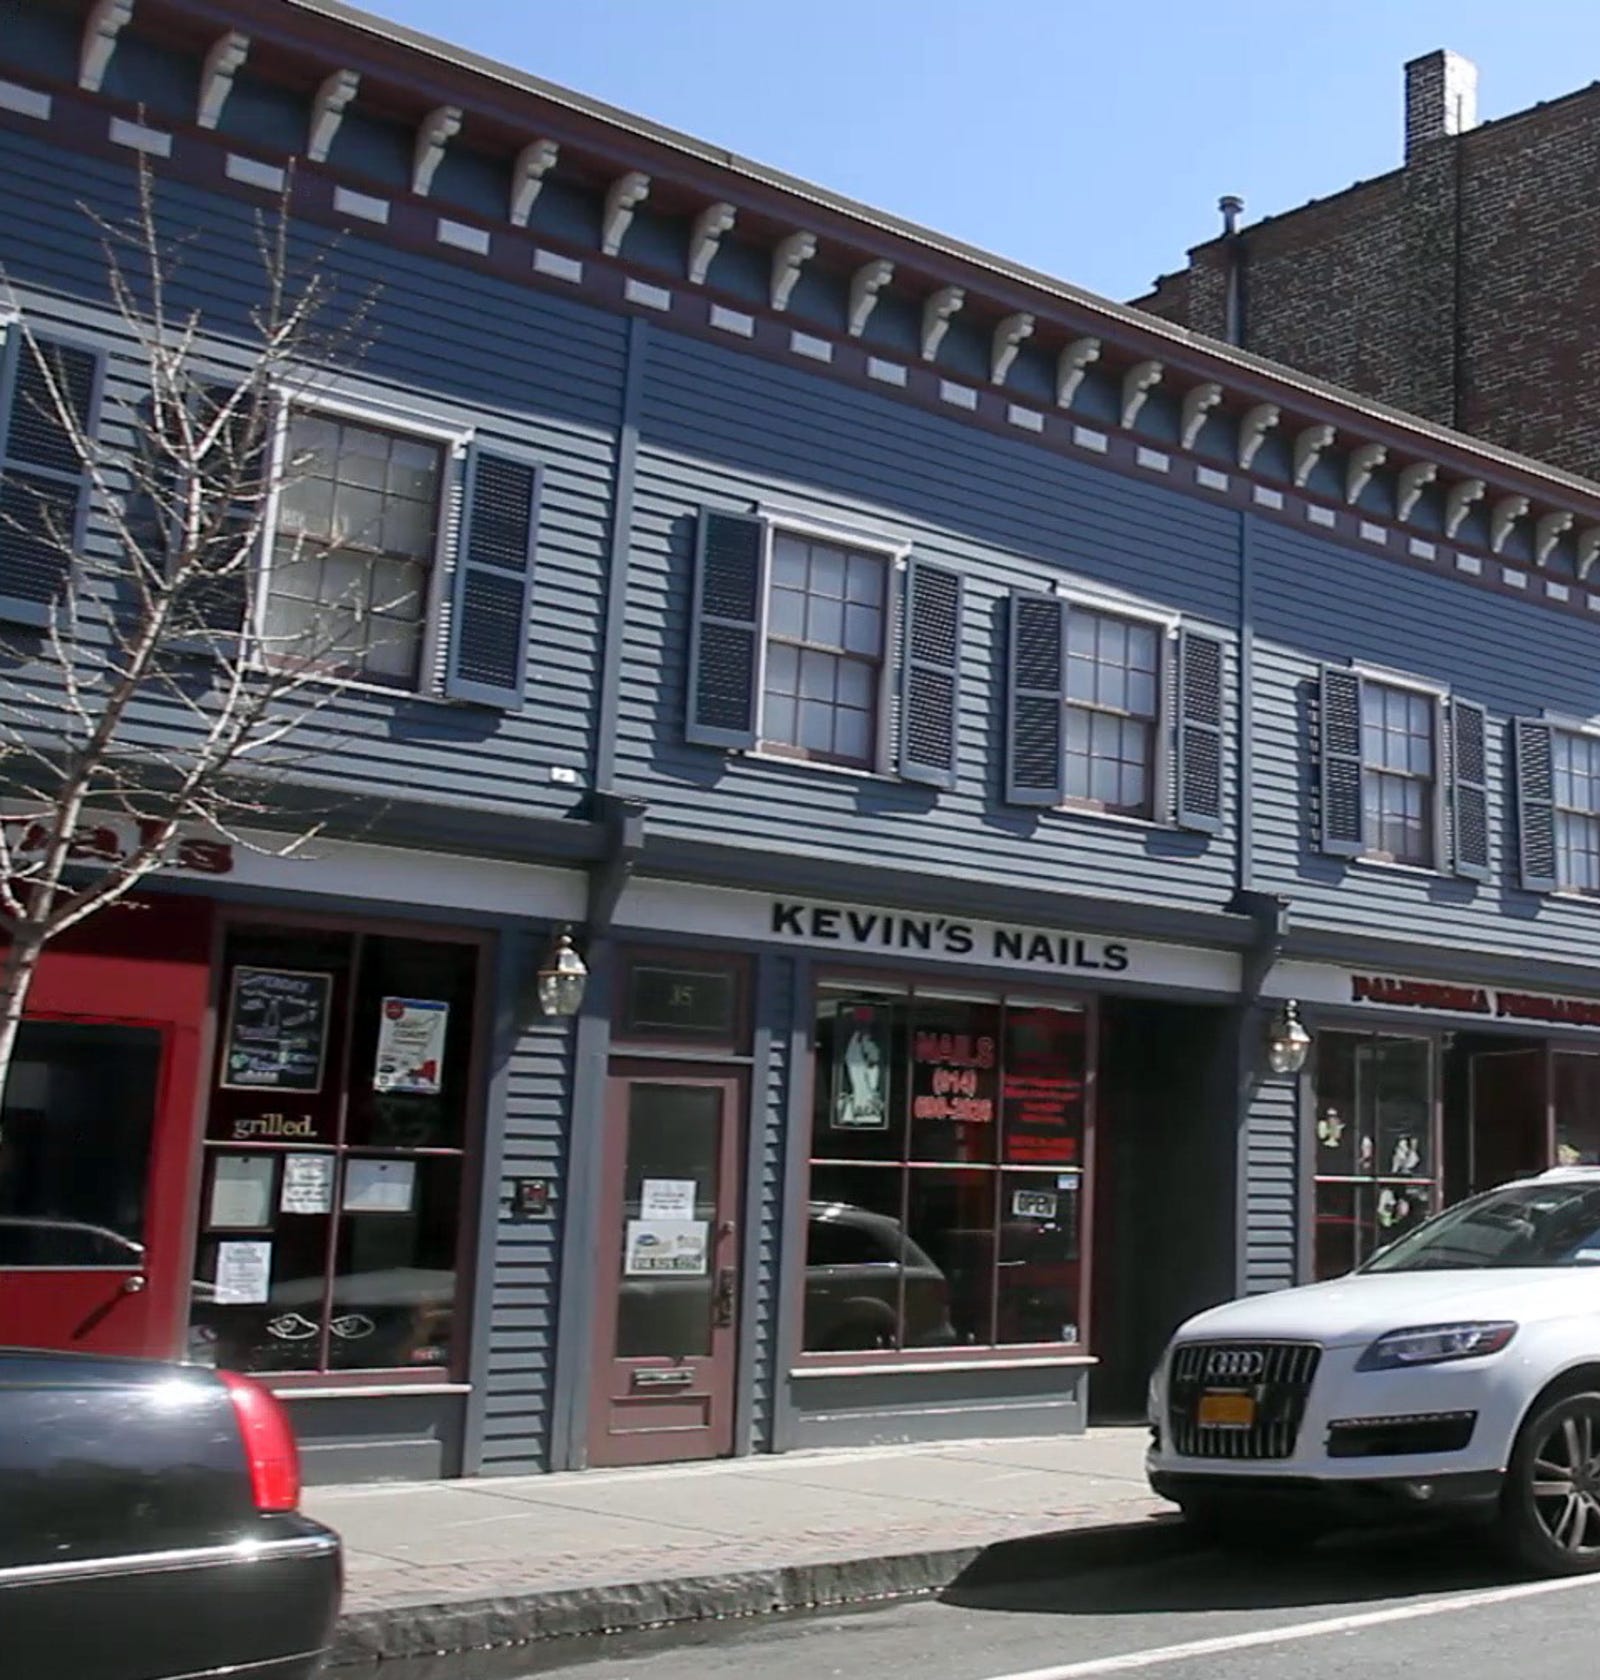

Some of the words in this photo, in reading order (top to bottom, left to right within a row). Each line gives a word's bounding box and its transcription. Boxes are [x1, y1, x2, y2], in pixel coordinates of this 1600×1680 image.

[770, 903, 974, 954] KEVIN'S
[993, 931, 1129, 971] NAILS
[232, 1113, 318, 1139] grilled.
[1018, 1192, 1053, 1216] OPEN
